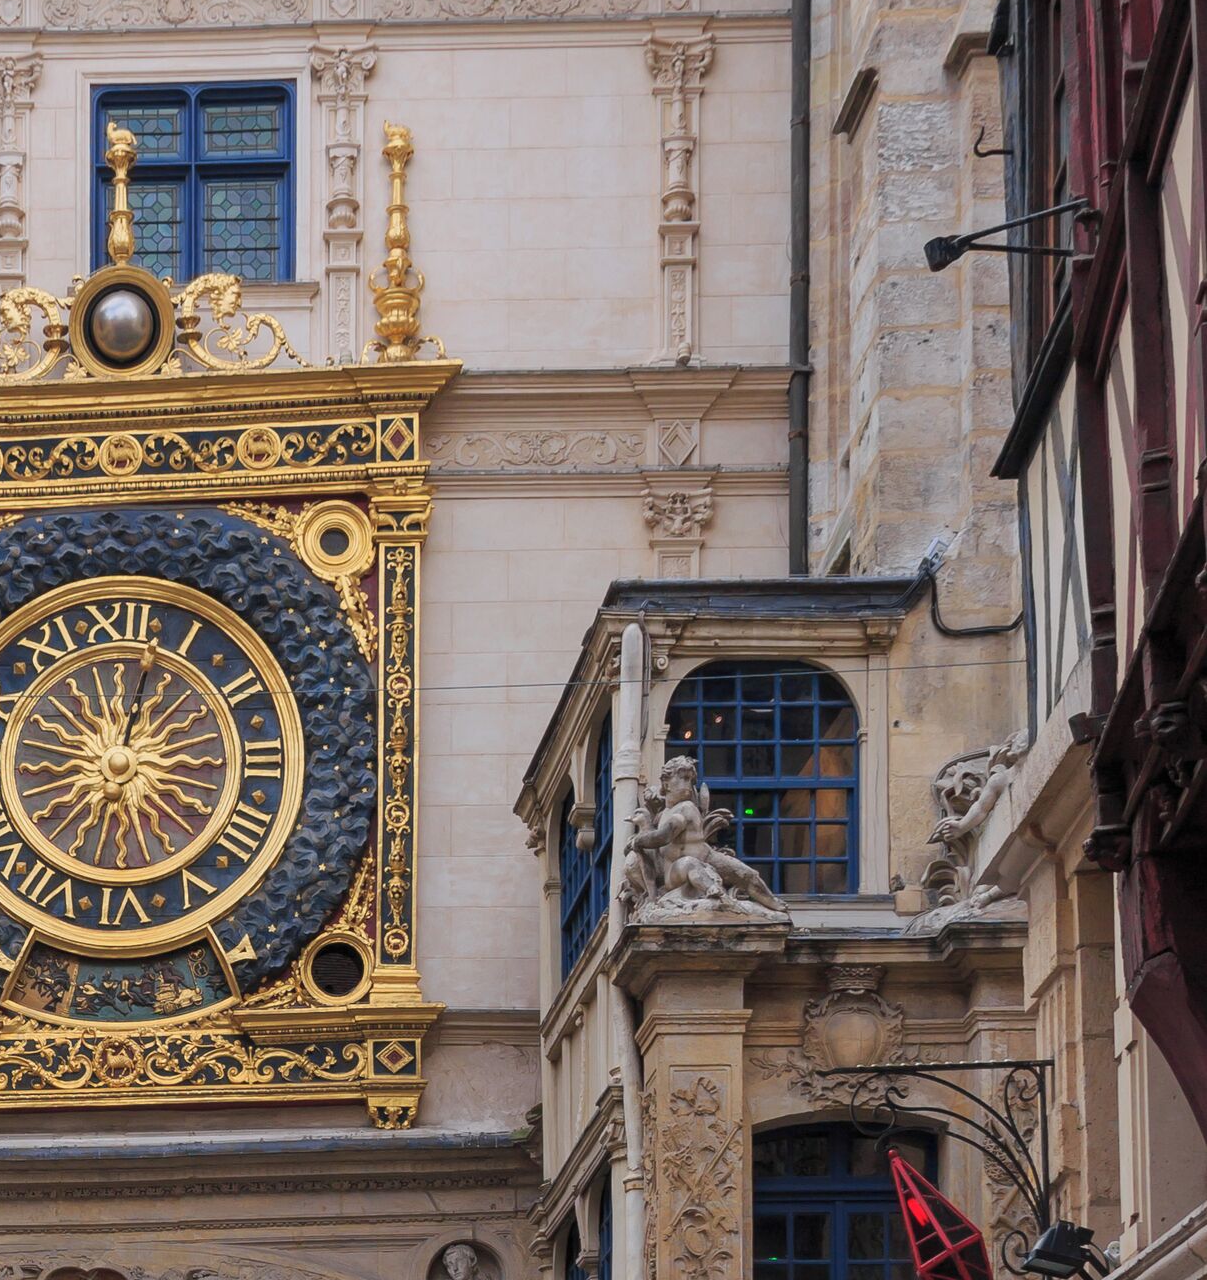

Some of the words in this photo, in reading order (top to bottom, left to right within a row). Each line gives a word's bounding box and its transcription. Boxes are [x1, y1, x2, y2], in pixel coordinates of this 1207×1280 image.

[17, 615, 78, 673] XI
[85, 602, 151, 644] XII
[177, 620, 203, 657] I
[221, 668, 264, 708] II
[244, 737, 281, 779] III
[216, 800, 273, 863] IIII
[17, 859, 77, 919] VII
[98, 887, 152, 925] VI
[182, 869, 218, 910] V
